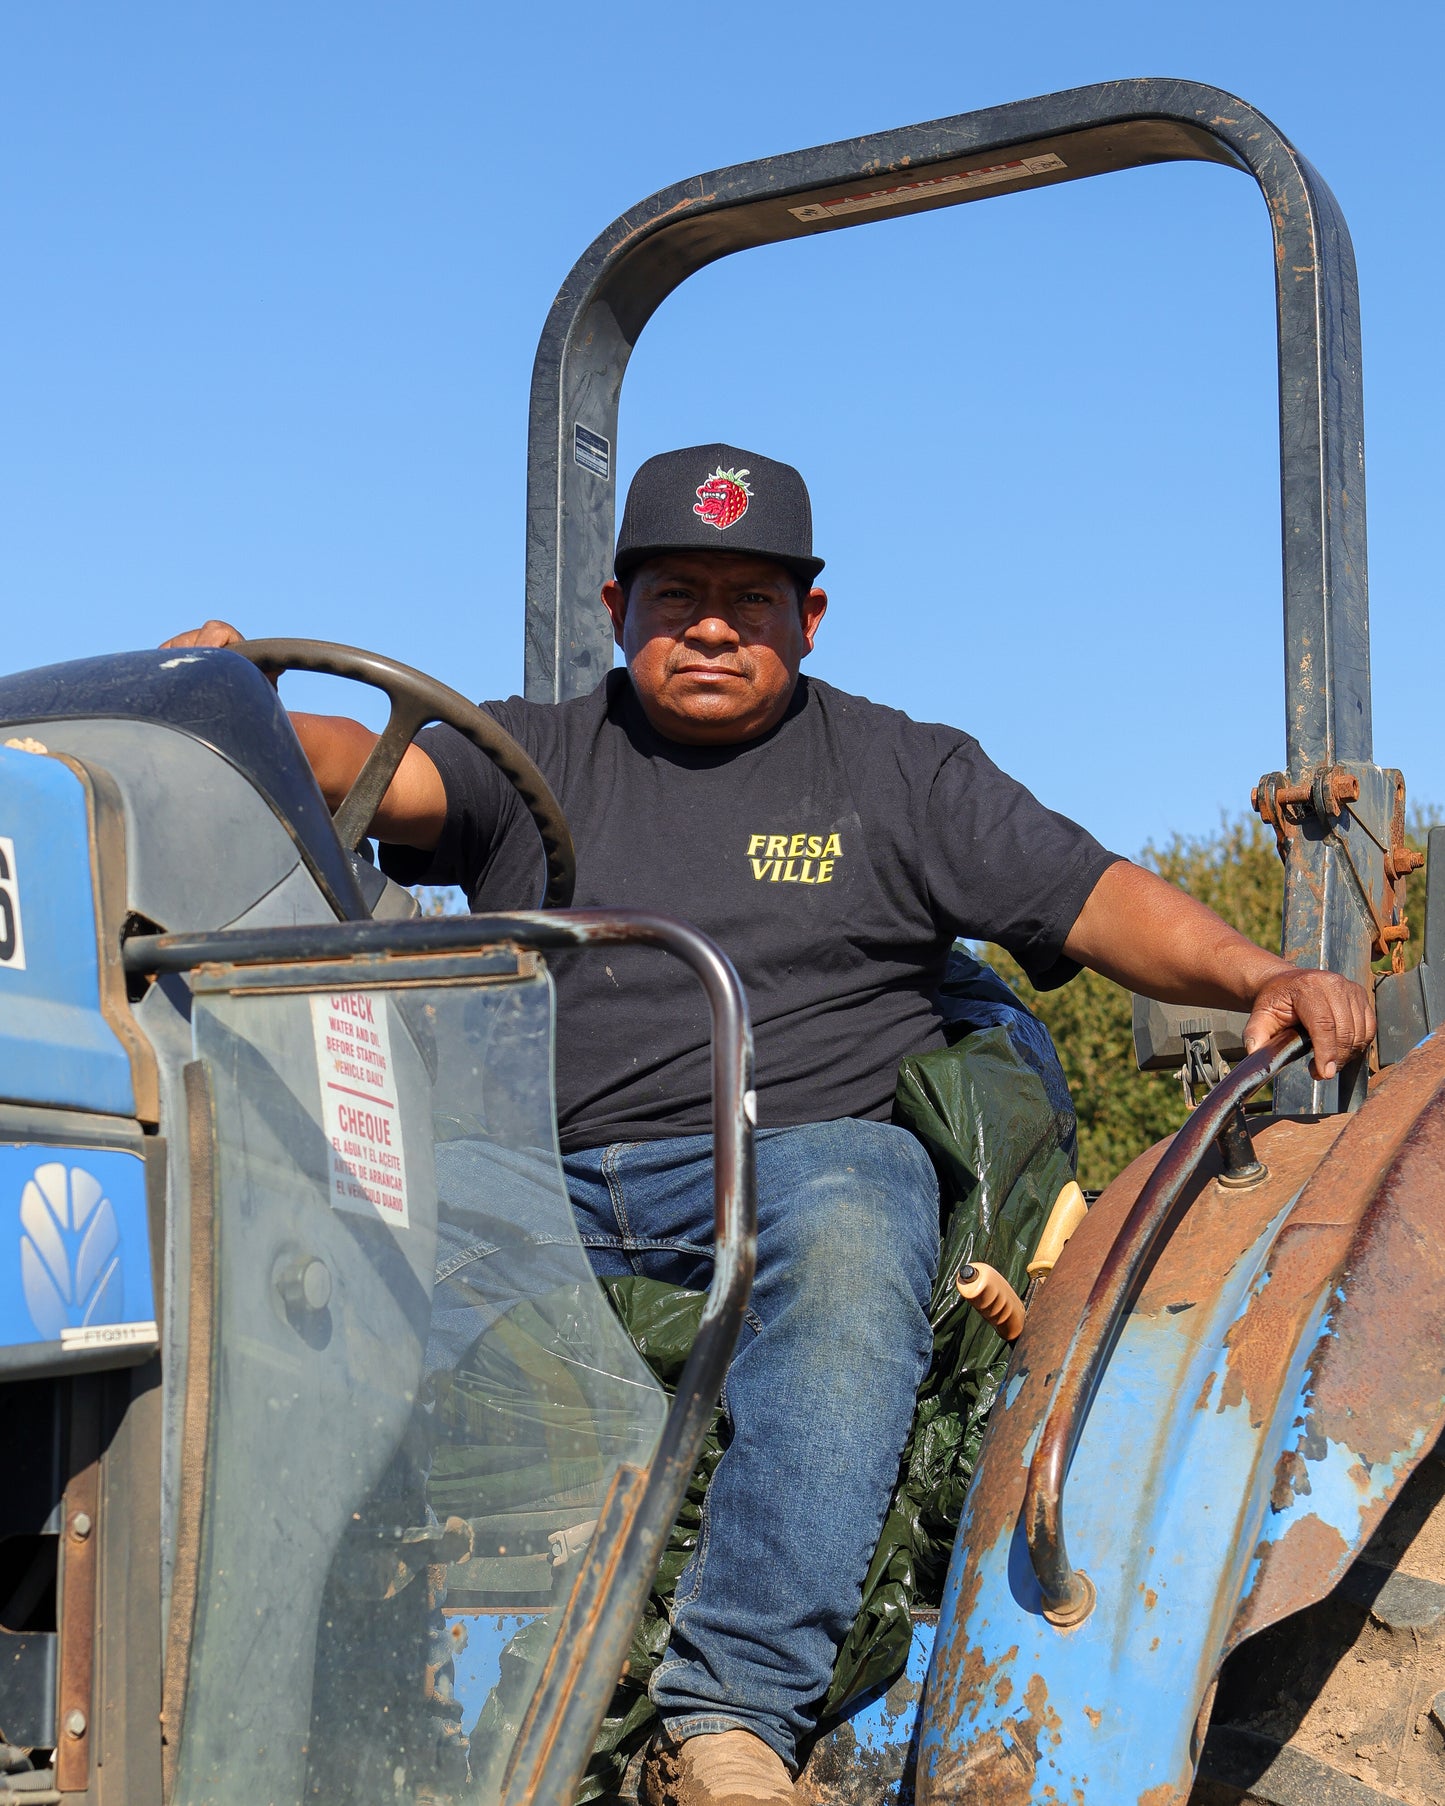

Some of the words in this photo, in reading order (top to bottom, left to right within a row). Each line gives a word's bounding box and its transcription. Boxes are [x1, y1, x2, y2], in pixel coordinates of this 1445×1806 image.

[870, 165, 1007, 196] DANGER
[746, 833, 843, 858] FRESA
[750, 858, 835, 884] VILLE
[330, 993, 375, 1024] CHECK
[328, 1016, 354, 1038] WATER
[356, 1026, 369, 1042] AND
[326, 1035, 355, 1058] BEFORE
[356, 1046, 387, 1070] STARTING
[335, 1058, 365, 1081] VEHICLE
[366, 1068, 384, 1088] DAILY
[338, 1104, 392, 1147] CHEQUE
[333, 1137, 341, 1152] EL
[344, 1140, 362, 1158] AGUA
[362, 1146, 367, 1159] Y
[369, 1147, 377, 1163] EL
[379, 1151, 401, 1171] ACEITE
[334, 1158, 357, 1177] ANTES
[358, 1164, 369, 1181] DE
[369, 1169, 403, 1192] ARRANCAR
[336, 1180, 345, 1195] EL
[383, 1193, 403, 1212] DIARIO
